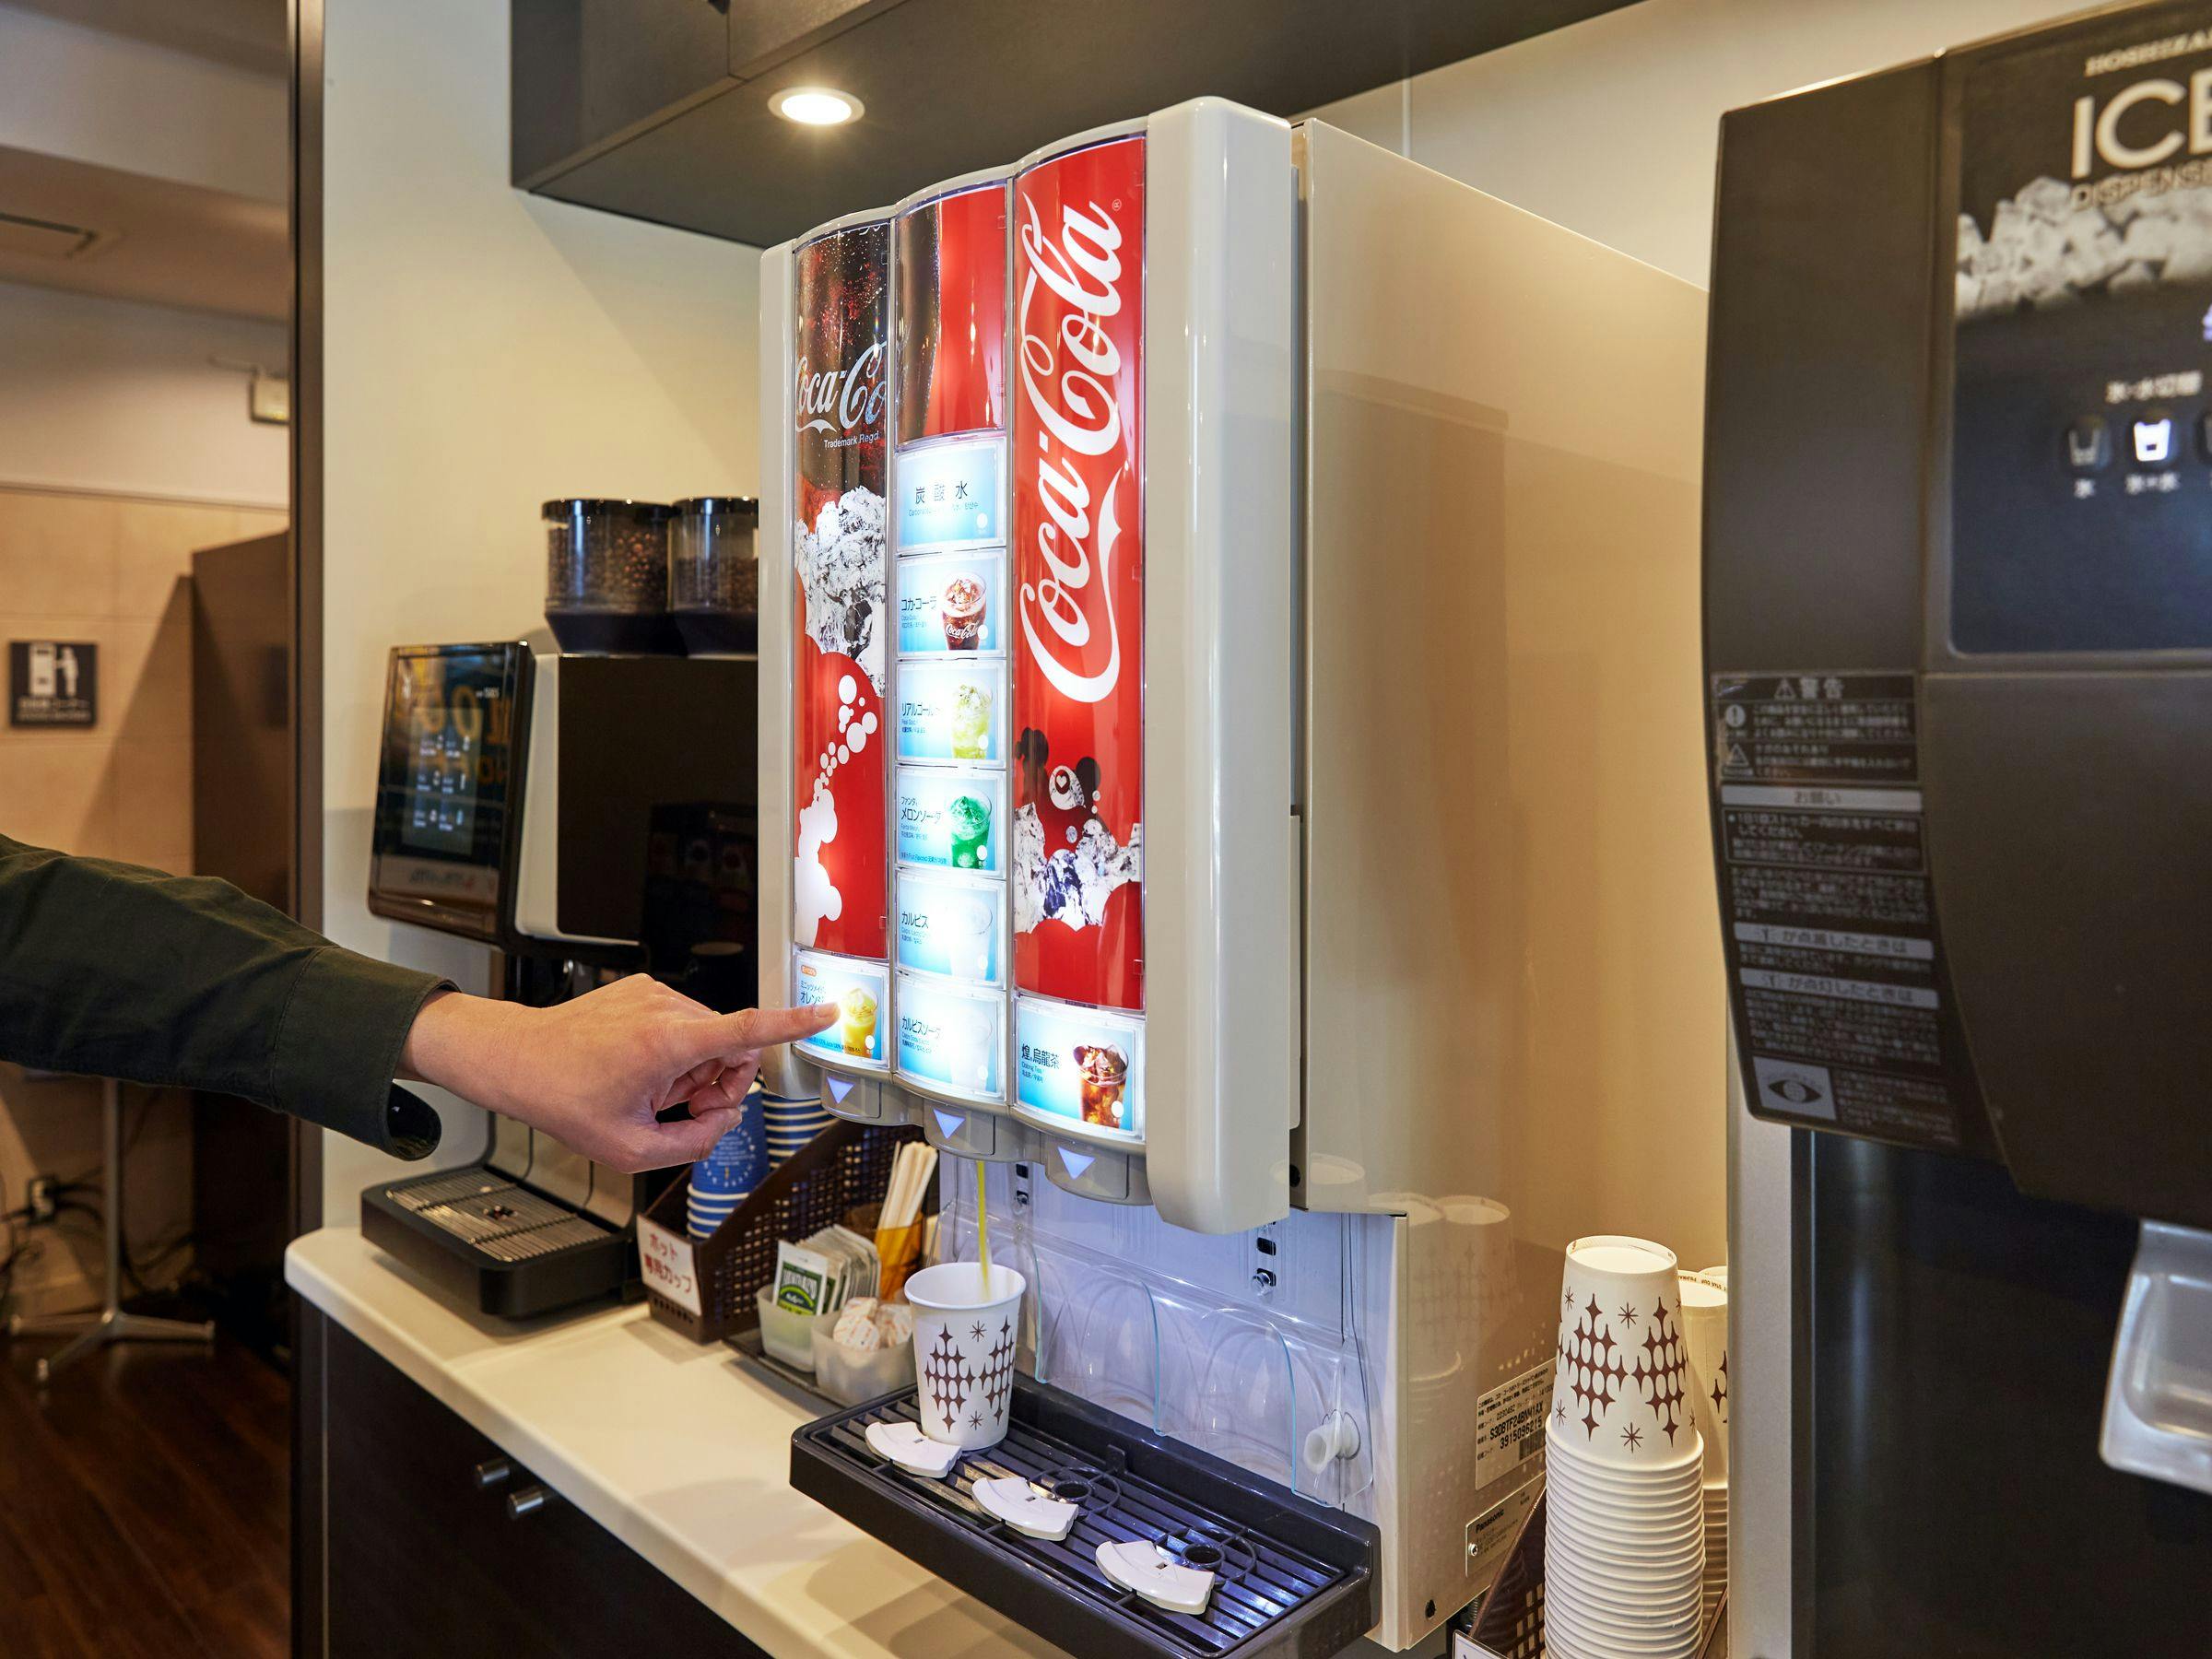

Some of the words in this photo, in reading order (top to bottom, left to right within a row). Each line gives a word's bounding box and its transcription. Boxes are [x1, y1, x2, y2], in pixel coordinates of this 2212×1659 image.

[2084, 28, 2212, 77] HOSHIZA
[823, 436, 857, 449] Trademark
[1019, 191, 1123, 703] Coca-Cola
[901, 911, 929, 929] カルピス
[650, 1233, 677, 1260] ホット
